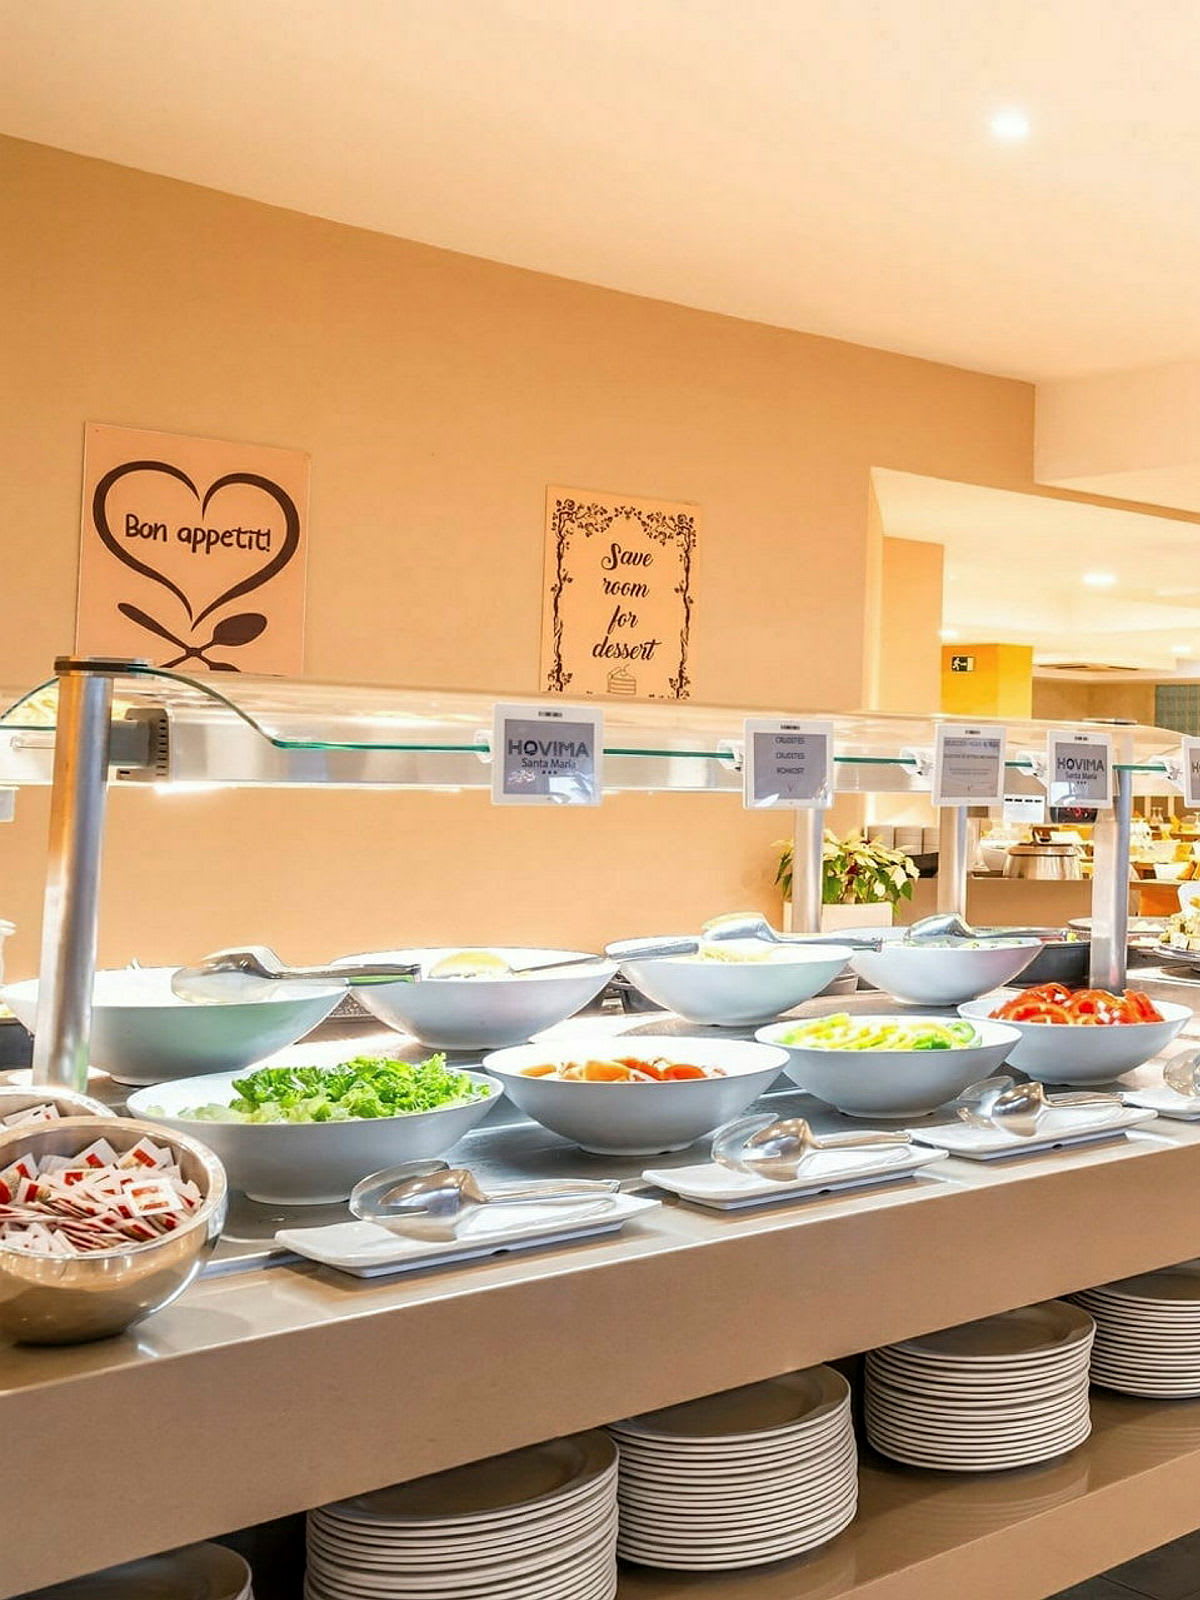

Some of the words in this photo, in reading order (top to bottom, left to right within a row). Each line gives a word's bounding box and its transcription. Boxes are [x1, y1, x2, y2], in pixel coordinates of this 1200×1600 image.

[125, 513, 168, 543] Bon
[177, 526, 271, 555] appetit!
[601, 543, 653, 571] Save
[602, 577, 650, 598] room
[607, 604, 639, 635] for
[592, 635, 663, 661] dessert
[508, 739, 590, 758] HOVIMA
[521, 757, 549, 769] Santa
[1057, 757, 1105, 772] HOVIMA
